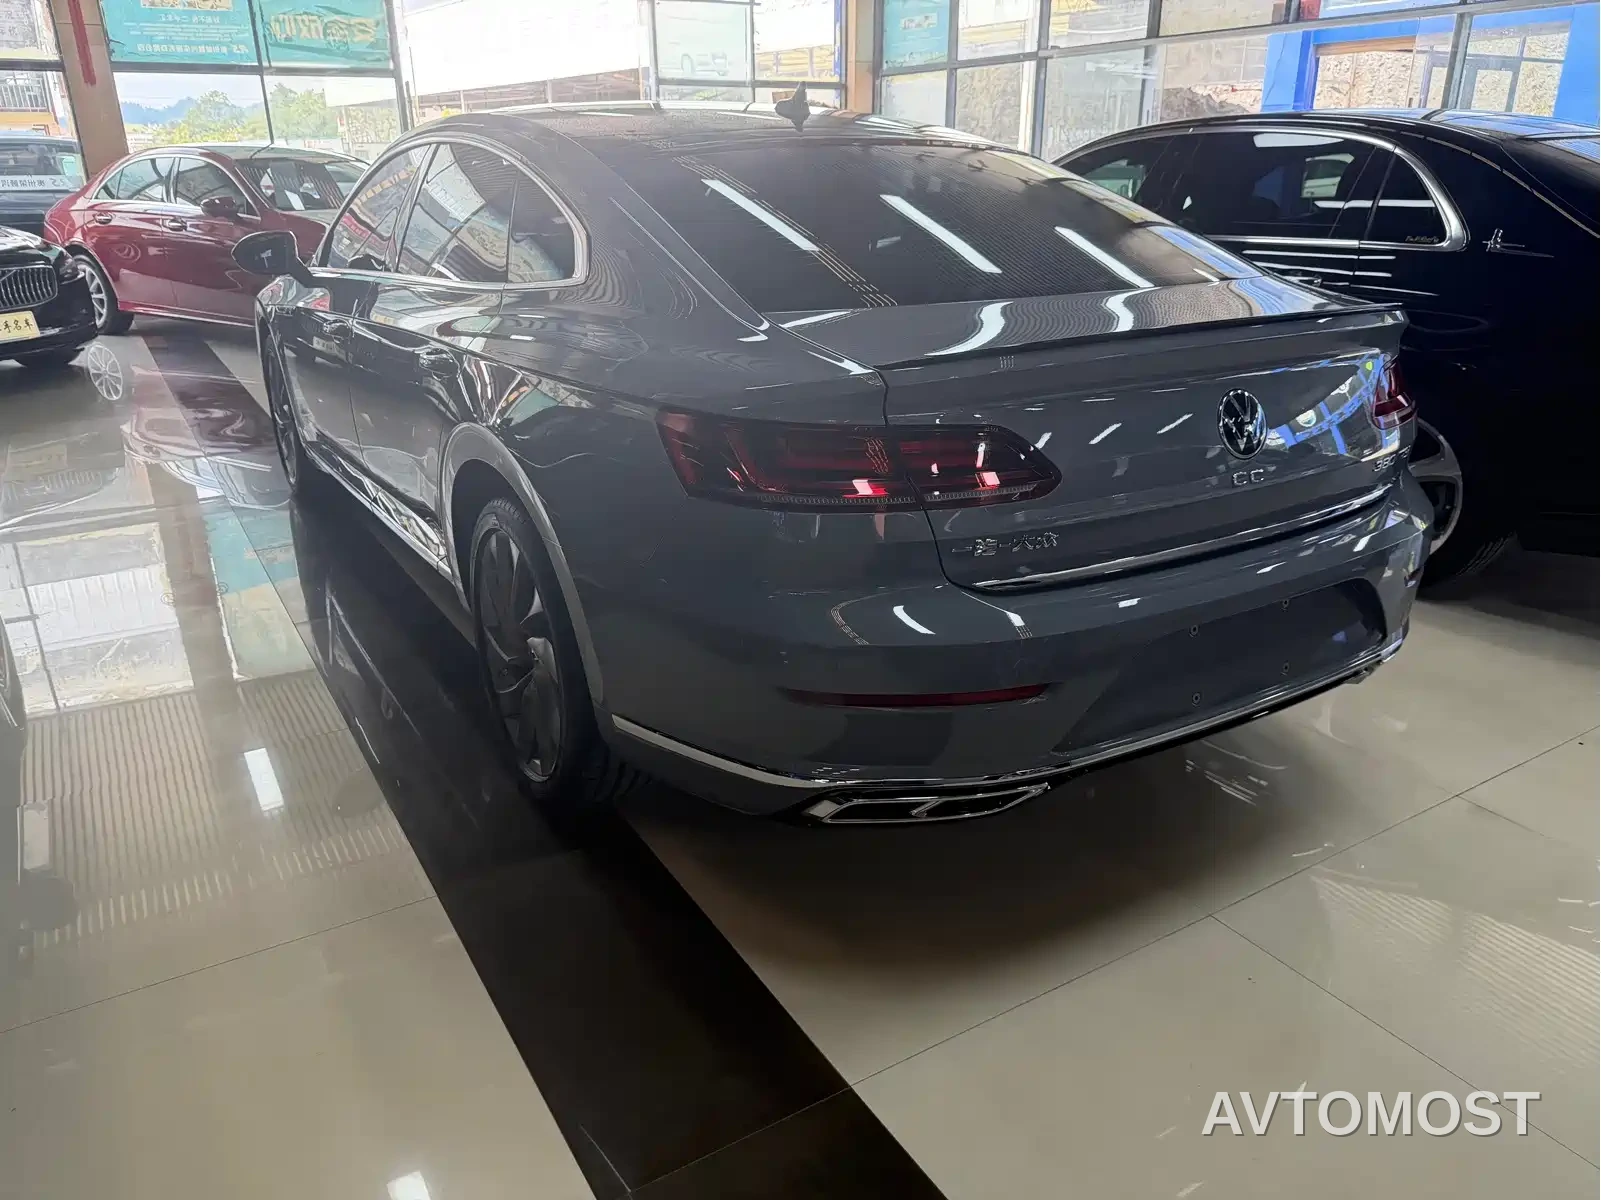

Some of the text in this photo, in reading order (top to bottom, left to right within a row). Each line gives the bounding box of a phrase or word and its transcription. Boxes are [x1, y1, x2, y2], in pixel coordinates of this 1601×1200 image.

[0, 318, 33, 333] 手名车
[1232, 468, 1265, 486] CC
